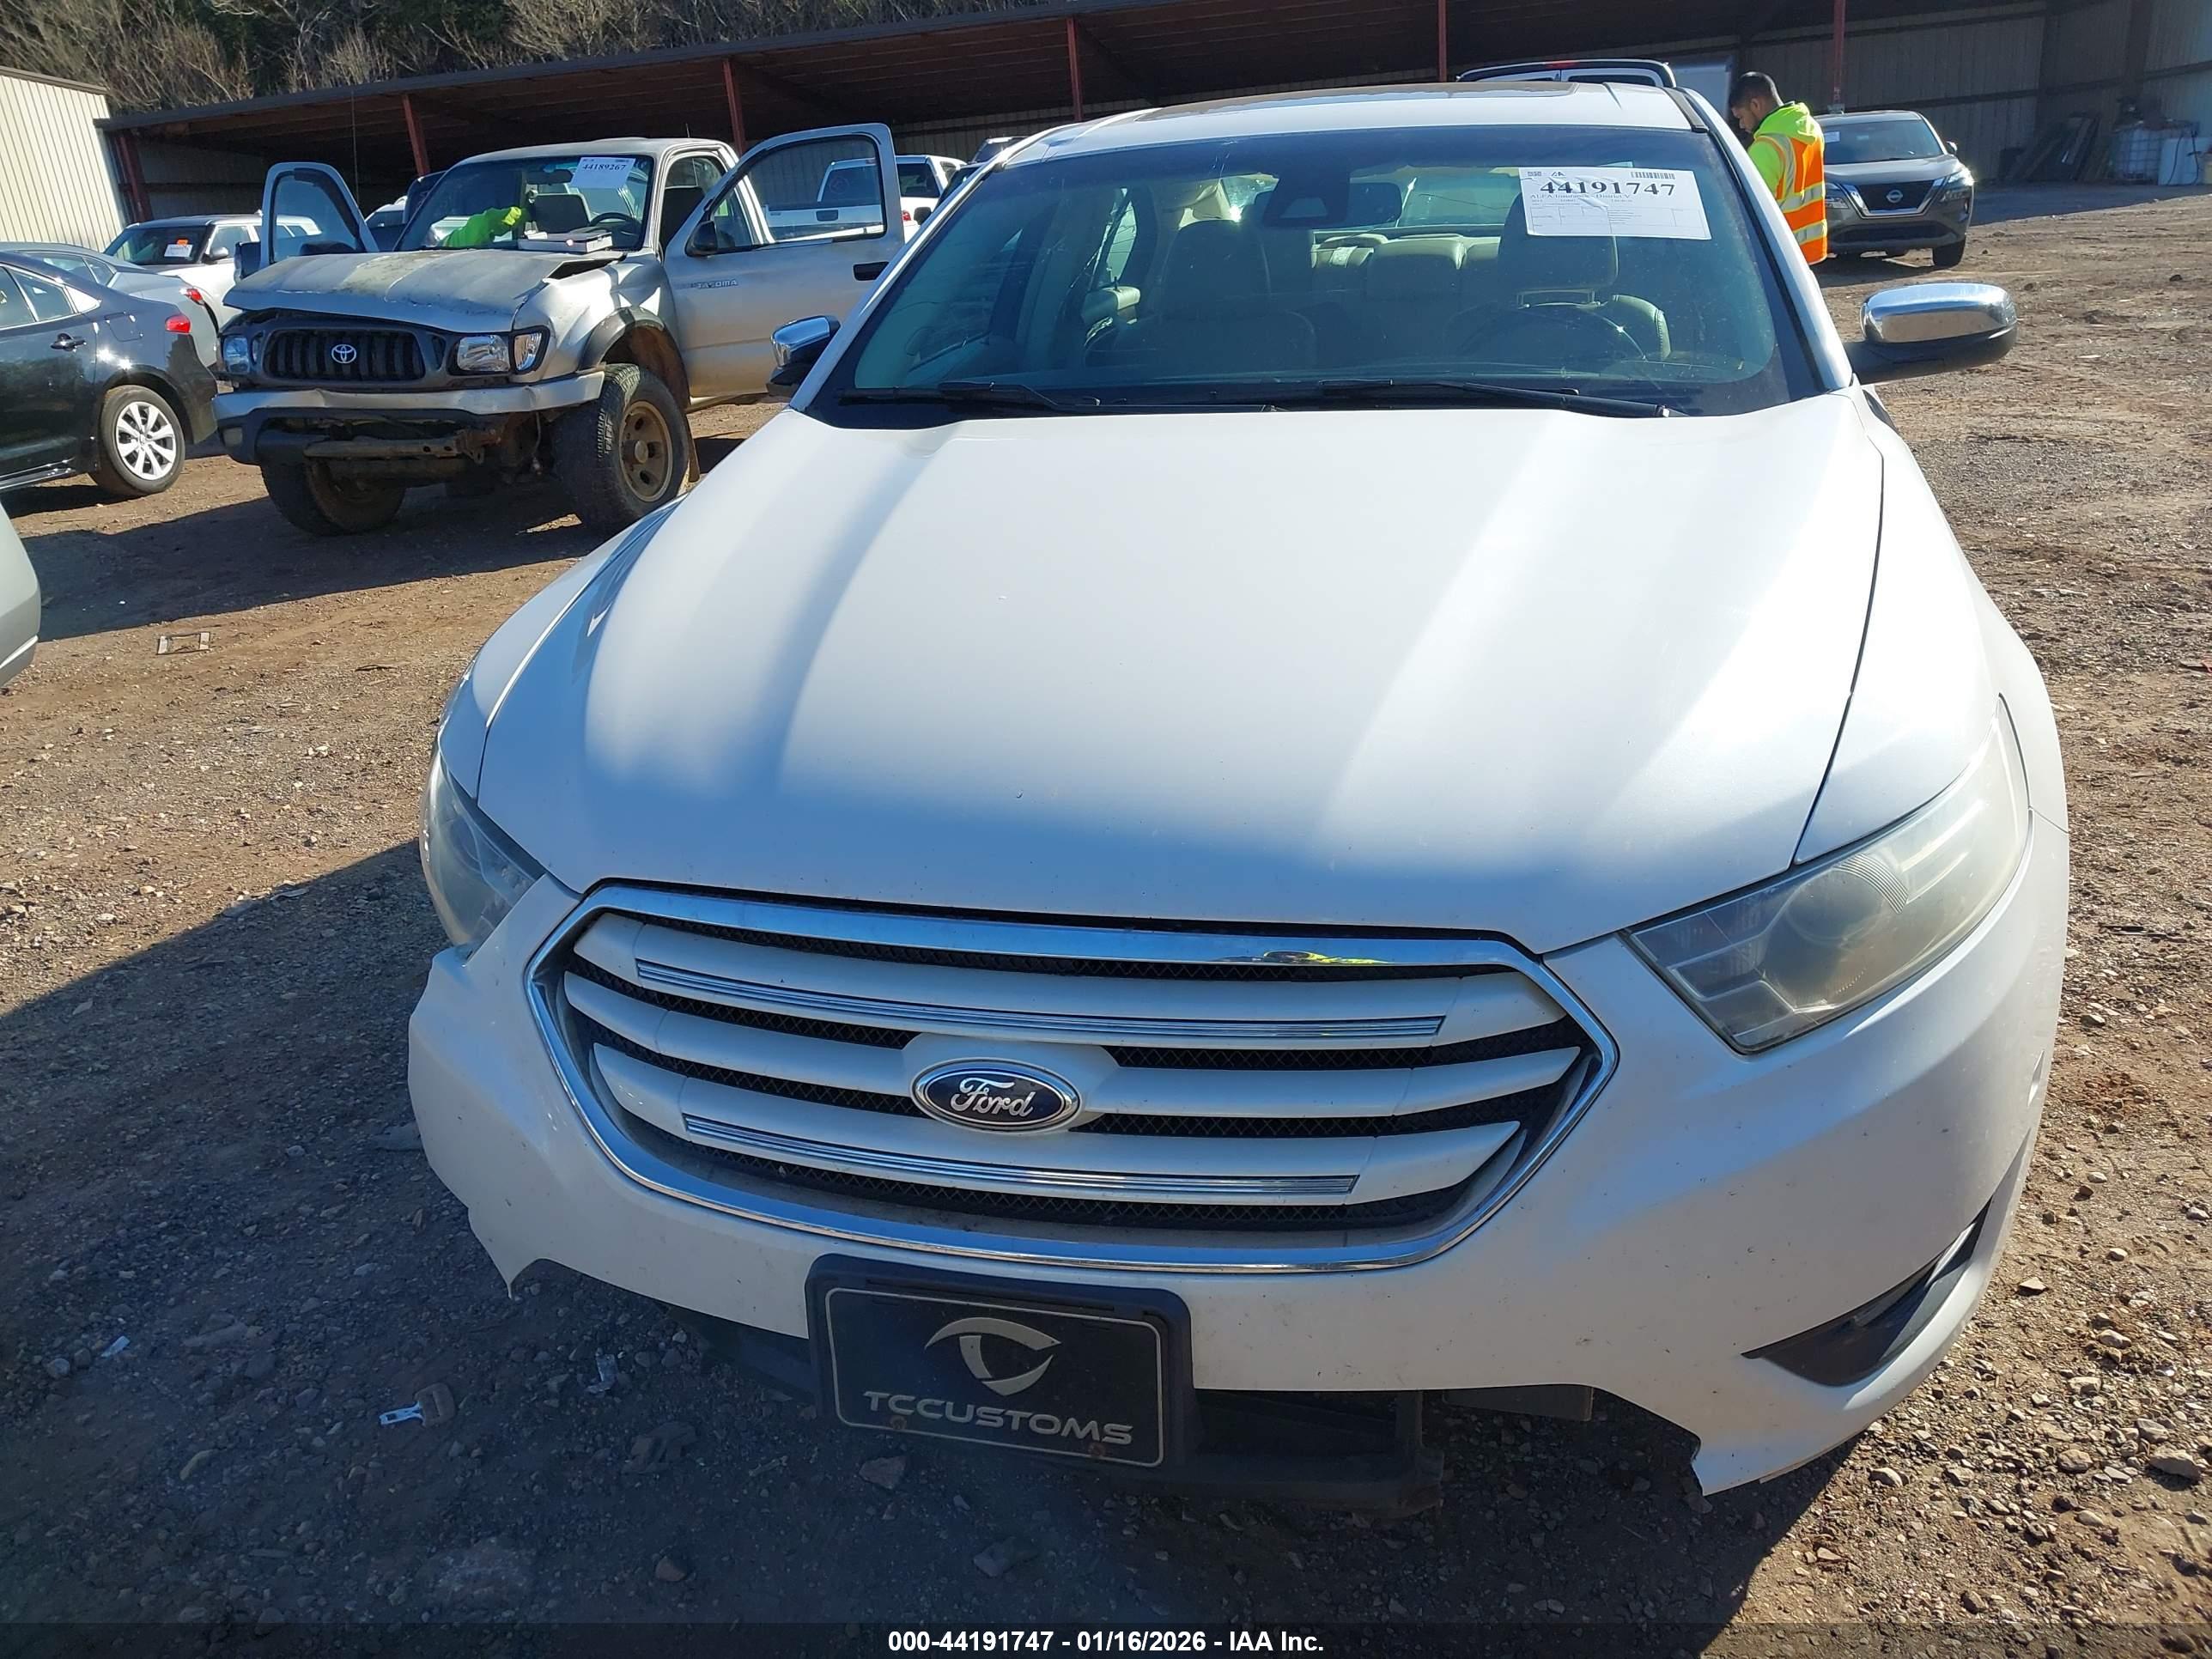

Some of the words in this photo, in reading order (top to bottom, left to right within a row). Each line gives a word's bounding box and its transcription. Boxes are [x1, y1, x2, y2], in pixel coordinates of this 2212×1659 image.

[1540, 181, 1675, 196] 44191747
[951, 1077, 1034, 1117] Ford
[863, 1390, 1133, 1446] TCCUSTOMS
